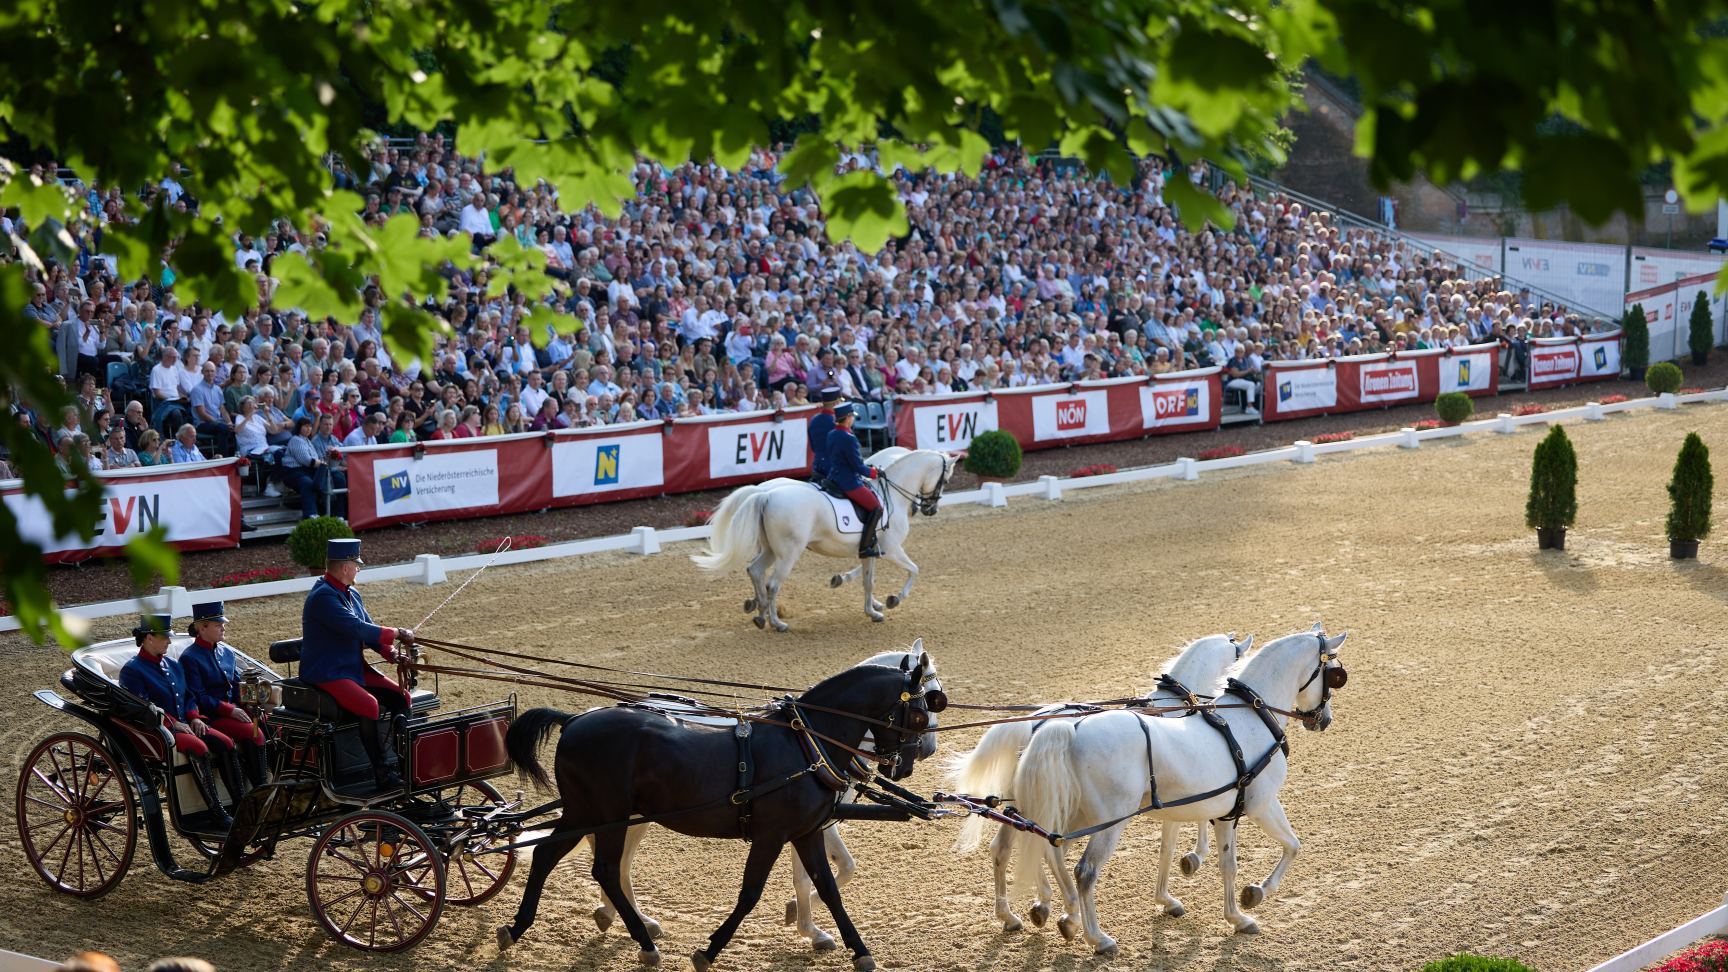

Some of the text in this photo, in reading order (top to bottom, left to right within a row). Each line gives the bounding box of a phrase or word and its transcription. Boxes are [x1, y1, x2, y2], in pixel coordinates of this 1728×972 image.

[1058, 403, 1085, 425] NÖN
[1156, 393, 1185, 415] ORF
[937, 412, 978, 443] EVN
[736, 429, 785, 465] EVN
[391, 476, 408, 489] NV
[415, 467, 494, 483] Die Niederösterreichische
[416, 484, 456, 496] Versicherung
